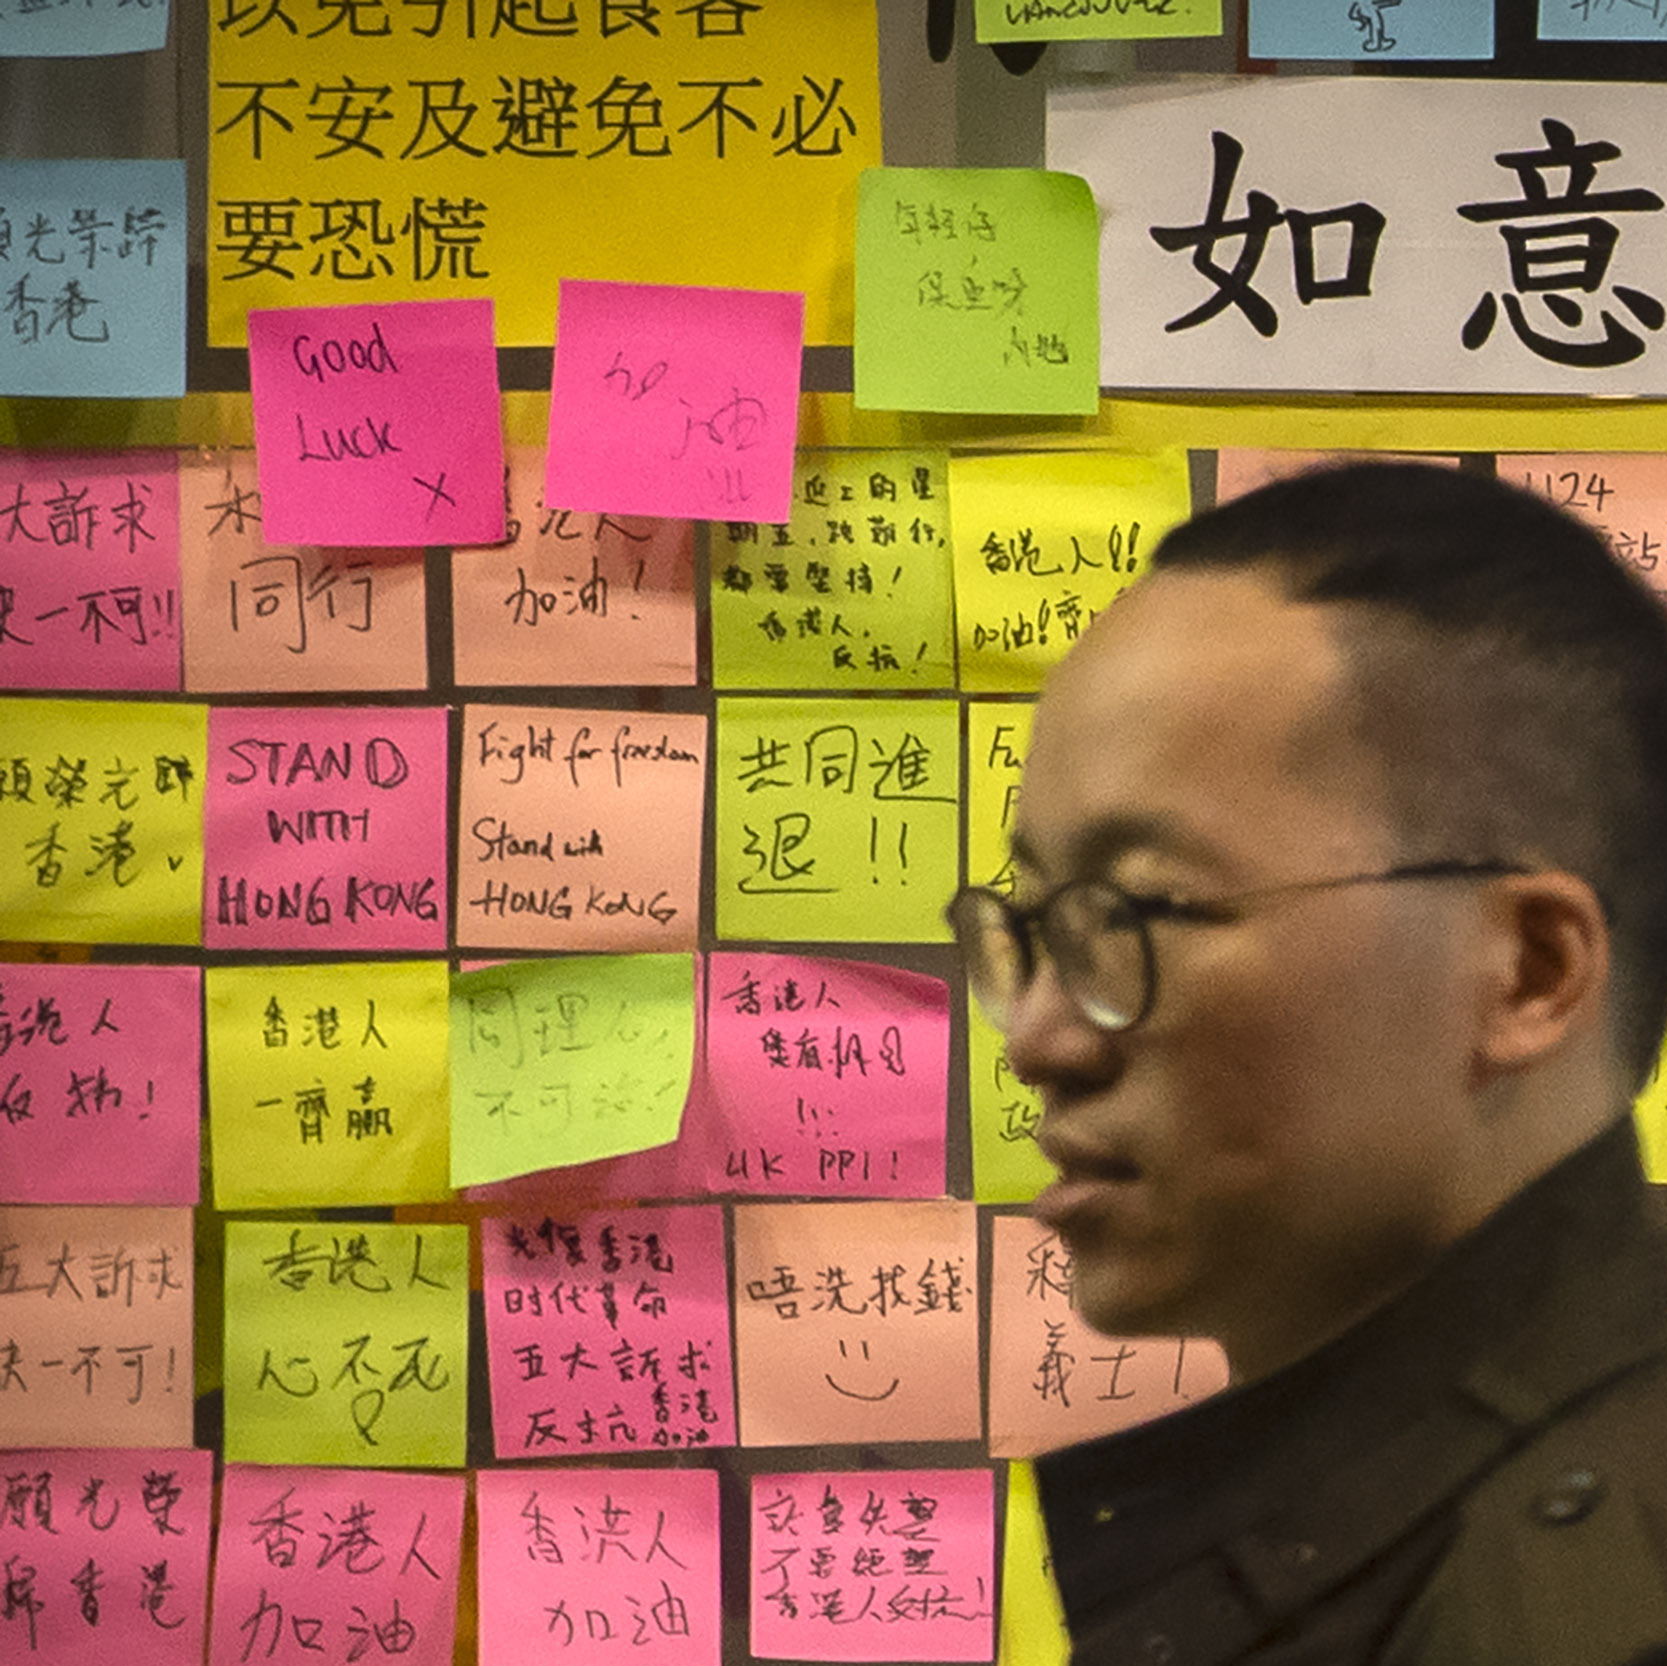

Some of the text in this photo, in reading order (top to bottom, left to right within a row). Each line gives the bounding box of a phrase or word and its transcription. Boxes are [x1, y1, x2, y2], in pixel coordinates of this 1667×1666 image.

[216, 74, 857, 162] 不安及避免不必
[222, 198, 490, 282] 要恐慌
[294, 326, 398, 376] Good
[296, 416, 400, 465] Luck
[226, 739, 409, 789] STAND
[478, 722, 604, 783] Fight for
[268, 809, 369, 843] WITH
[470, 819, 556, 864] Stand
[218, 877, 438, 926] HONG KONG
[470, 881, 571, 921] HONG
[263, 997, 388, 1049] 香港人
[249, 1489, 441, 1580] 香港人
[240, 1589, 414, 1662] 加油
